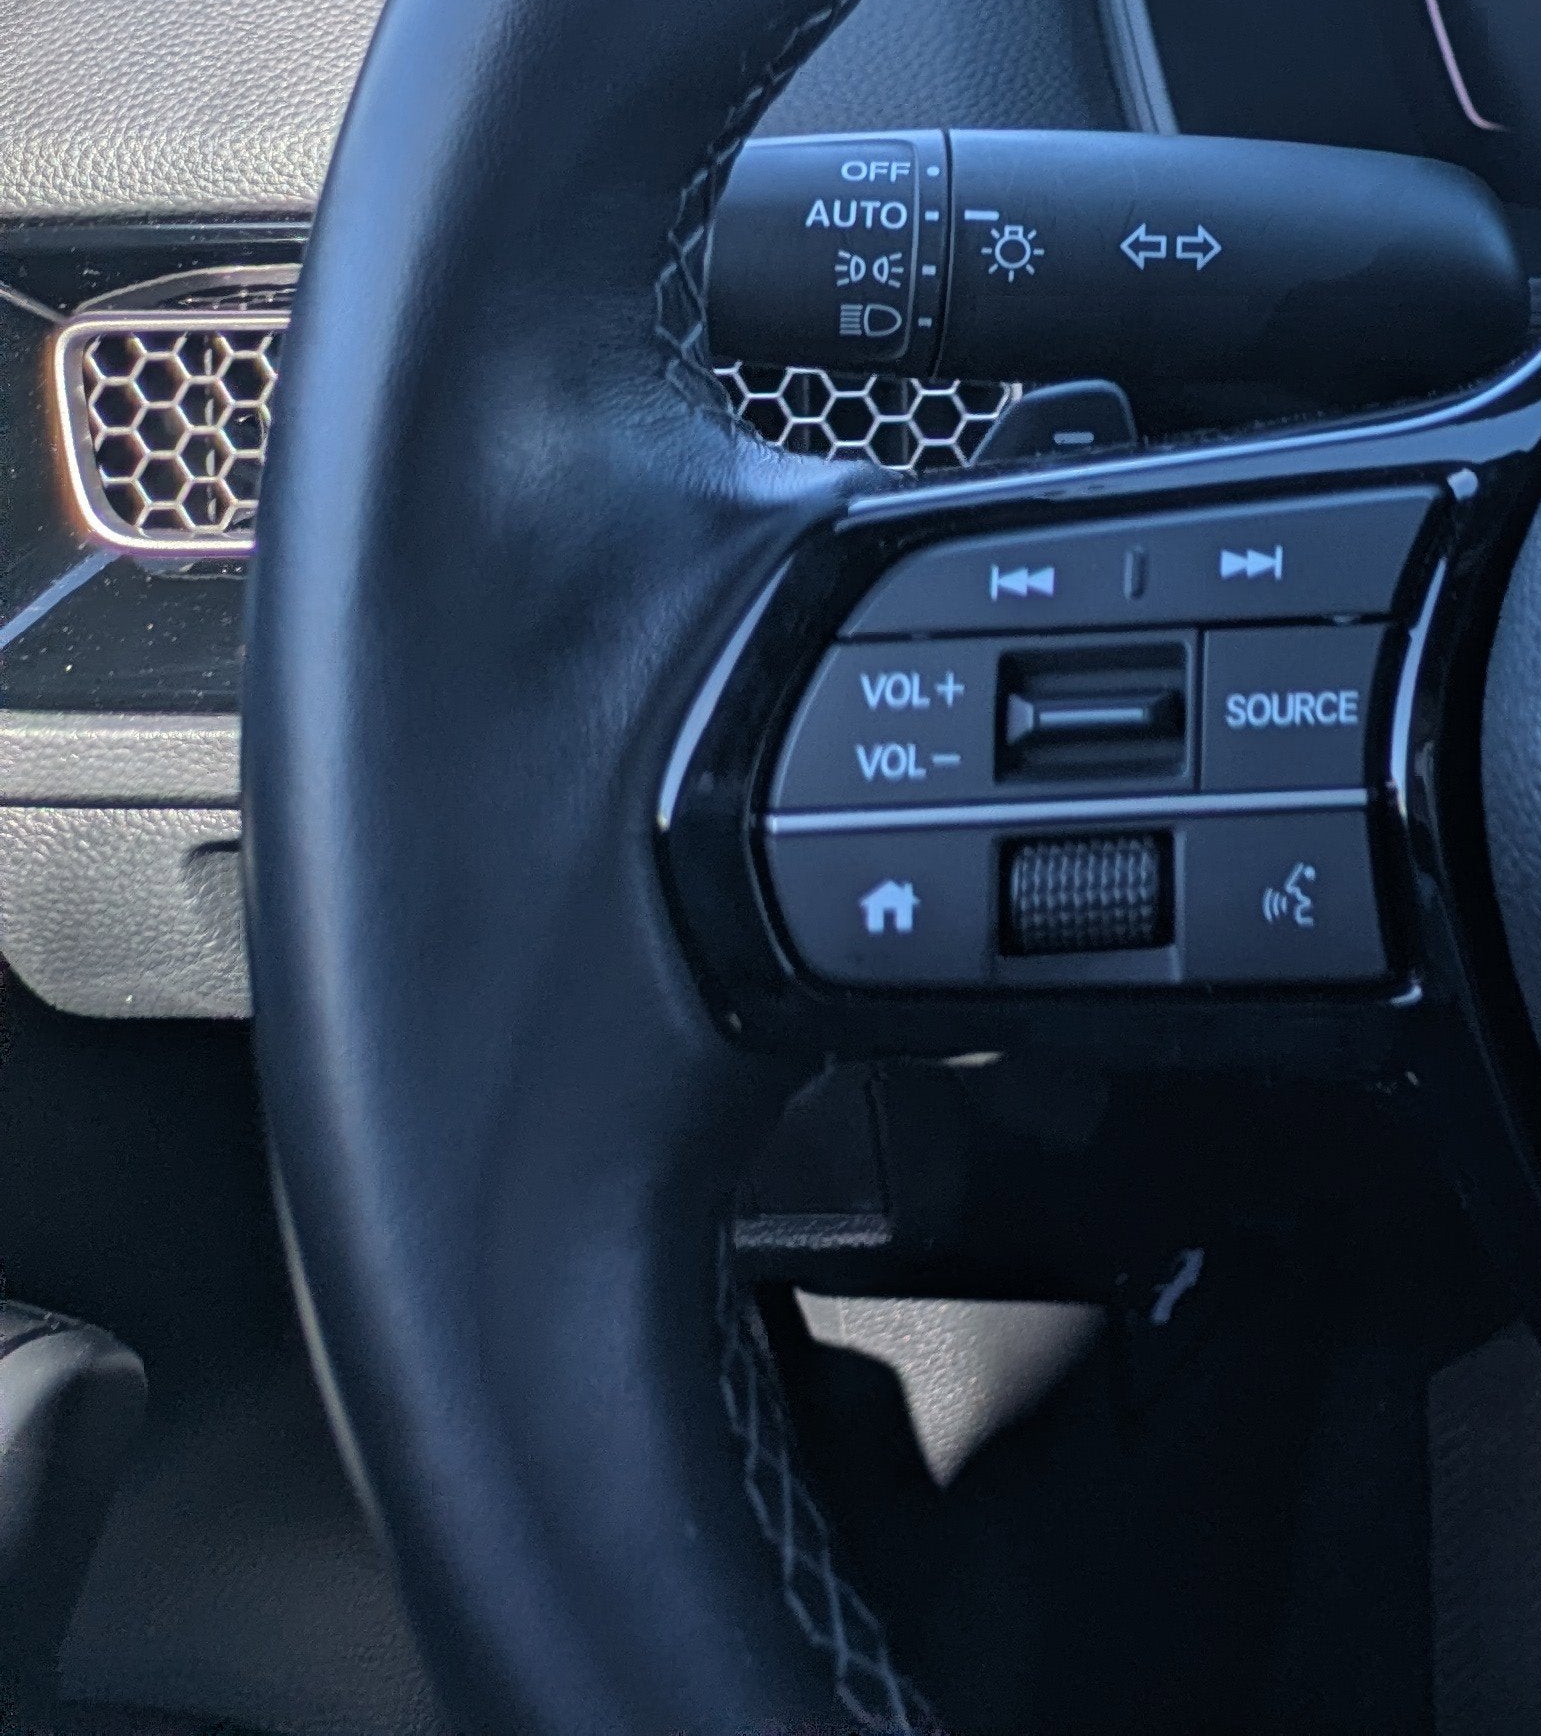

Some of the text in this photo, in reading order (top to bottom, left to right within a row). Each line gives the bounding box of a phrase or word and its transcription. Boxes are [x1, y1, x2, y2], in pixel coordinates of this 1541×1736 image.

[841, 161, 911, 183] OFF
[805, 199, 908, 229] AUTO
[1225, 690, 1359, 729] SOURCE
